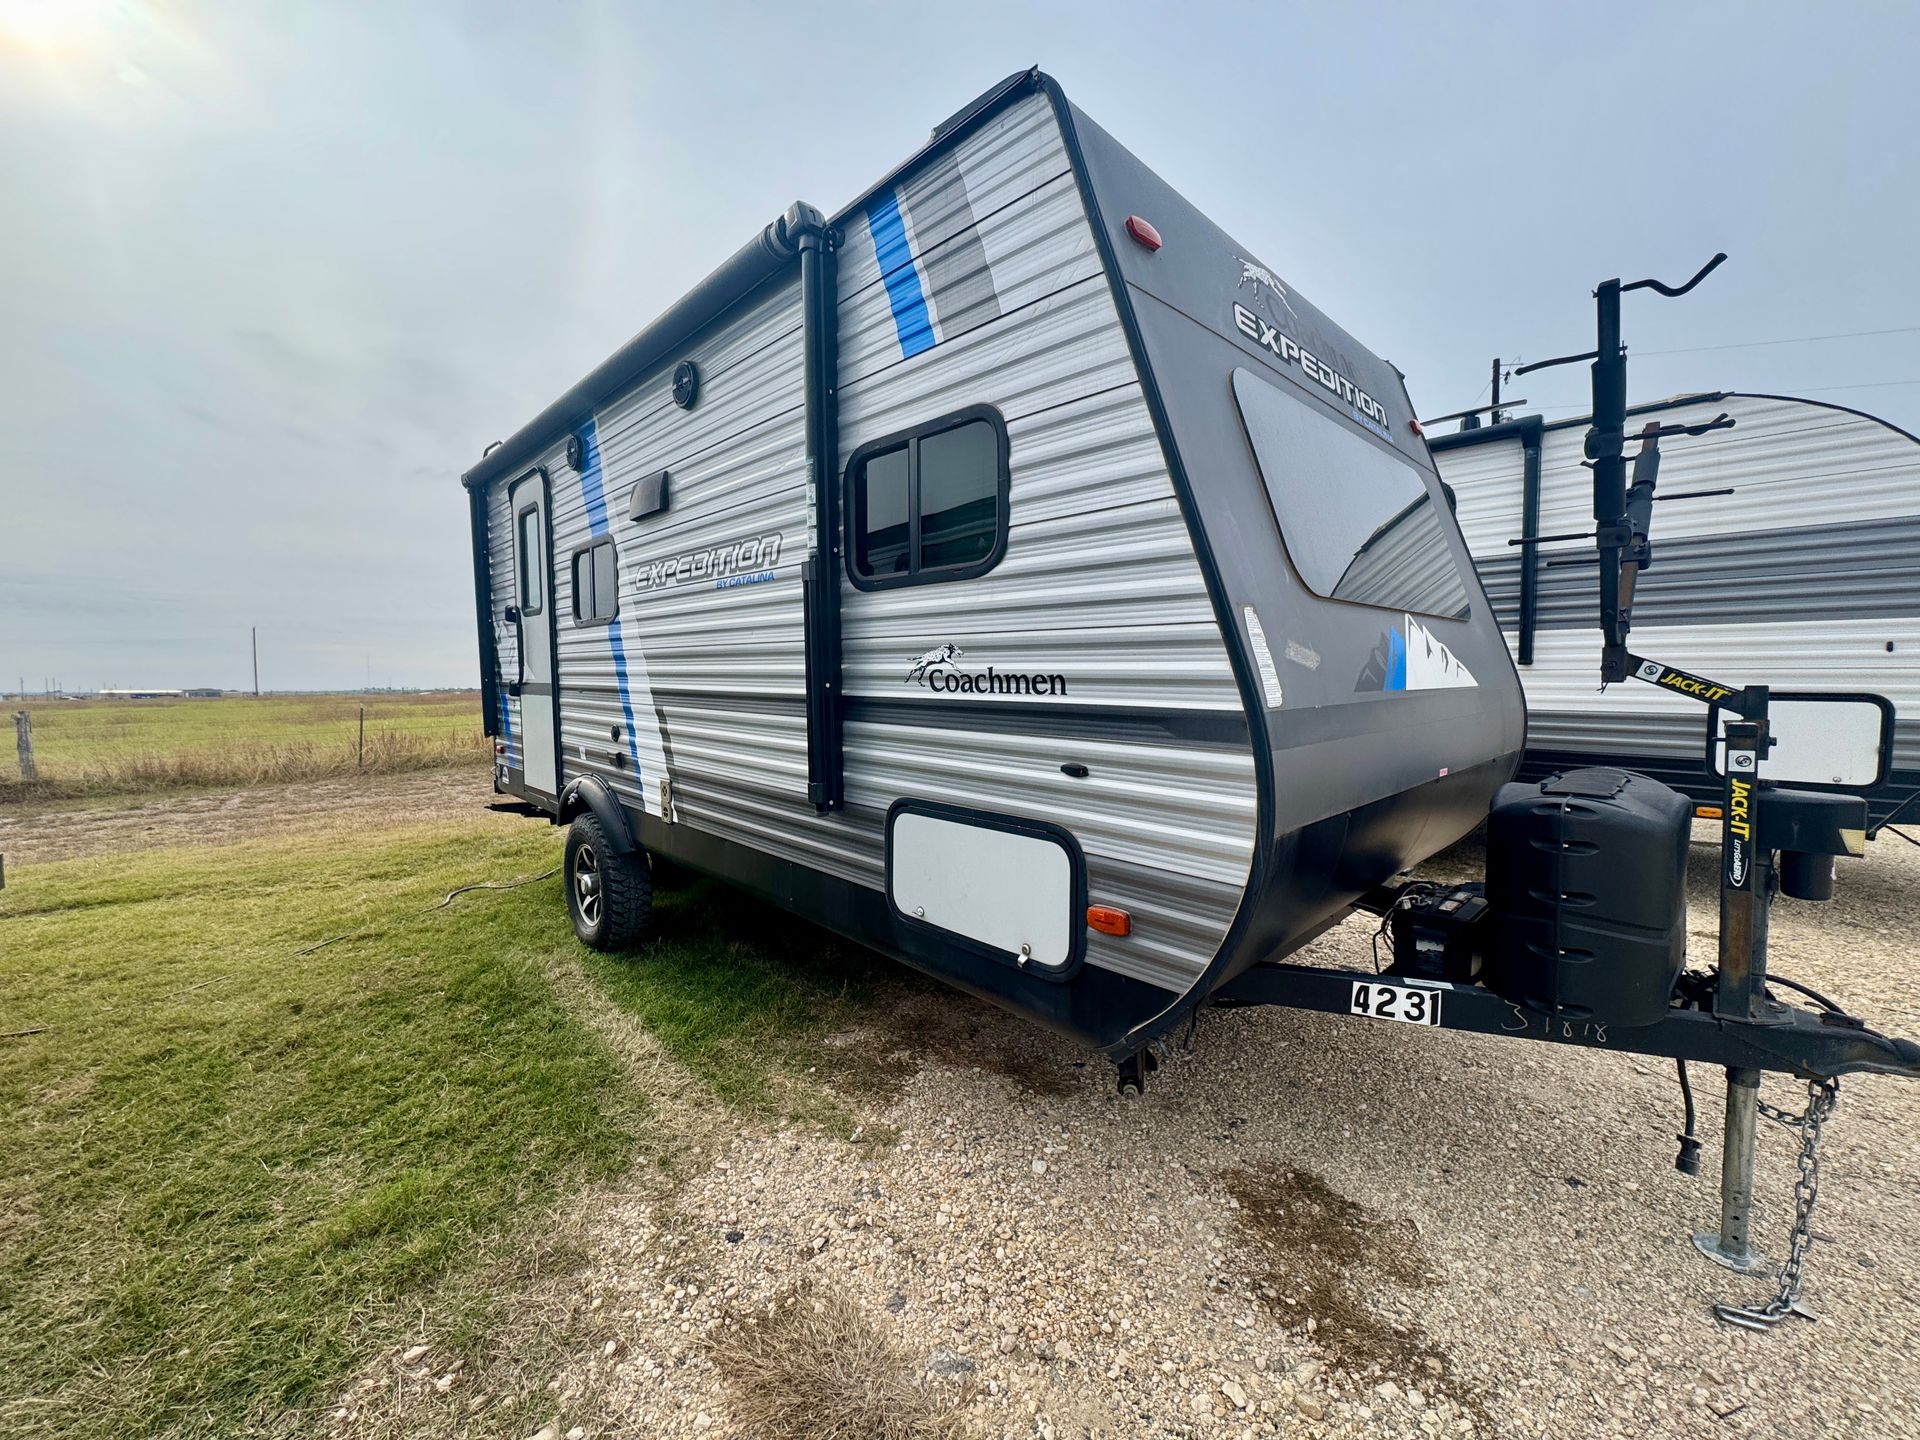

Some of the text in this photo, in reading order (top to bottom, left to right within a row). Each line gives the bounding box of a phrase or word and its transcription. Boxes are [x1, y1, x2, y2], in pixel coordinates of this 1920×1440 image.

[1233, 302, 1389, 430] EXPEDITION
[635, 532, 783, 591] EXPEDITION
[716, 571, 775, 589] BY CATALINA
[929, 667, 1067, 696] Coachmen
[1353, 985, 1440, 1026] 4231
